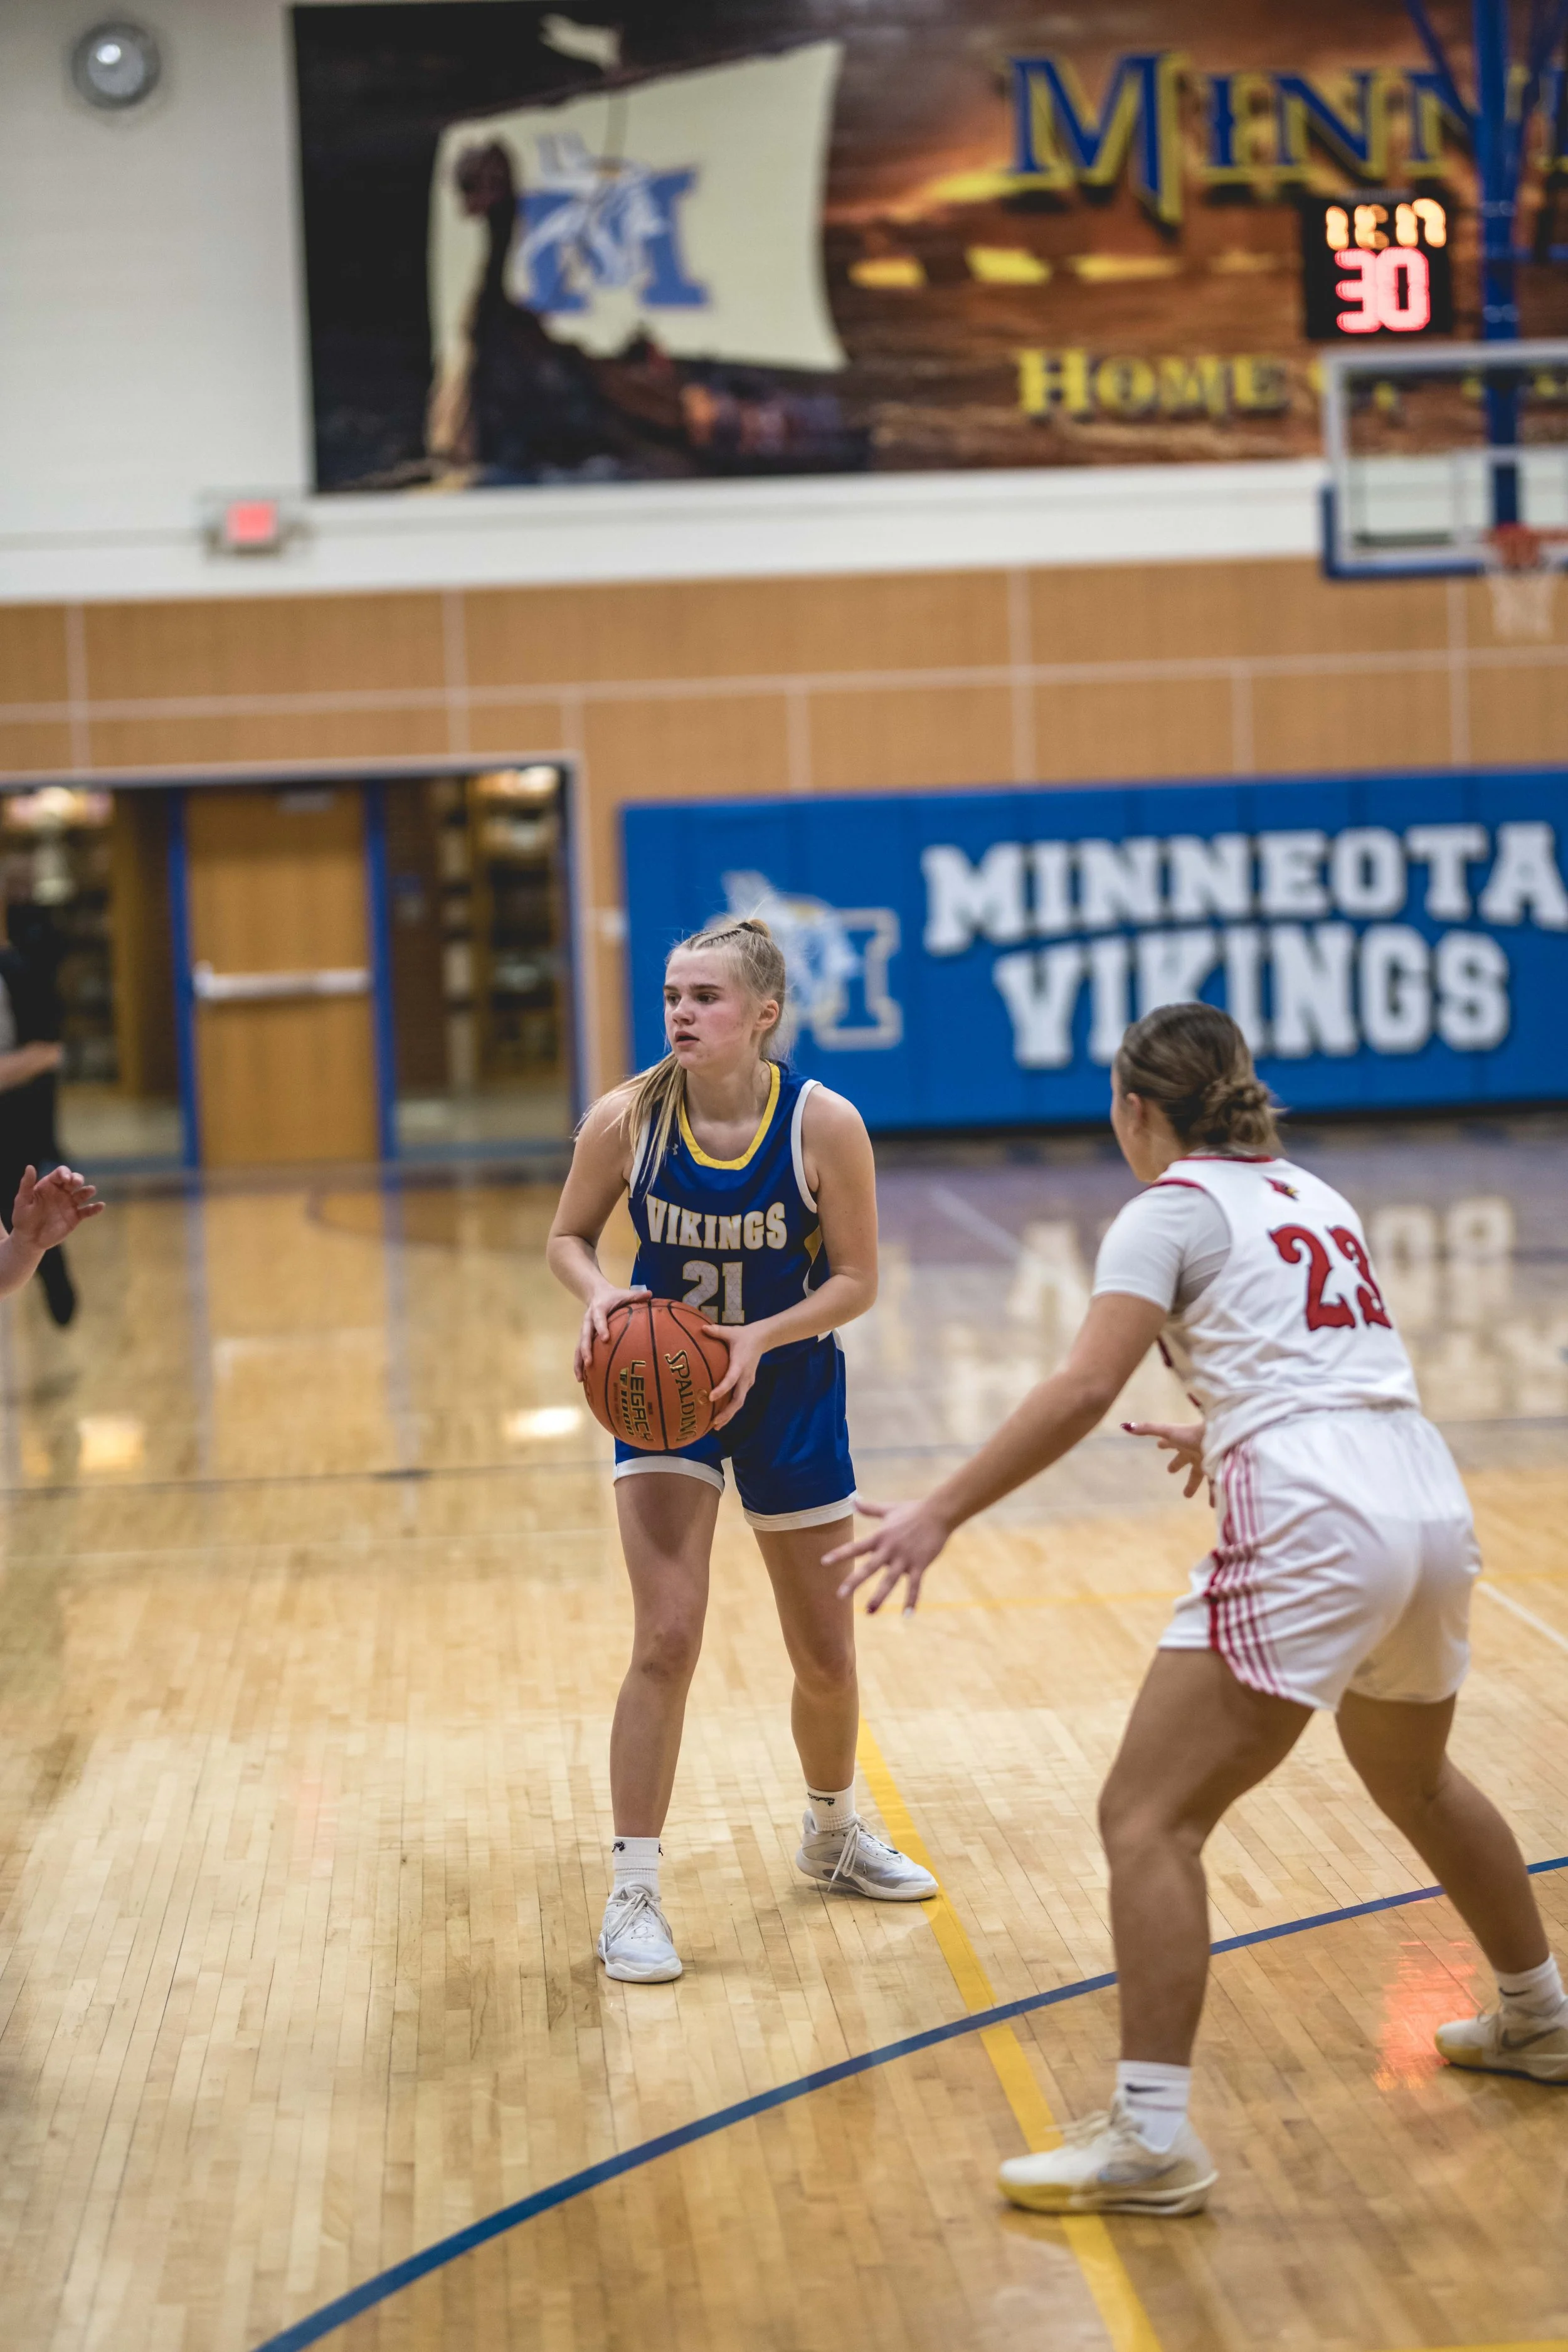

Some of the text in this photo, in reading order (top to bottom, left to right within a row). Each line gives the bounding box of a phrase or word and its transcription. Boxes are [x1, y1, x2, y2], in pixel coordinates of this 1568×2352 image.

[1335, 247, 1431, 333] 30
[1019, 347, 1288, 417] HOME
[921, 820, 1568, 958] MINNEOTA
[993, 923, 1508, 1069] VIKINGS
[646, 1194, 787, 1250] VIKINGS
[682, 1260, 744, 1323] 21
[630, 1360, 654, 1441] LEGACY
[664, 1350, 697, 1442] SPALDING
